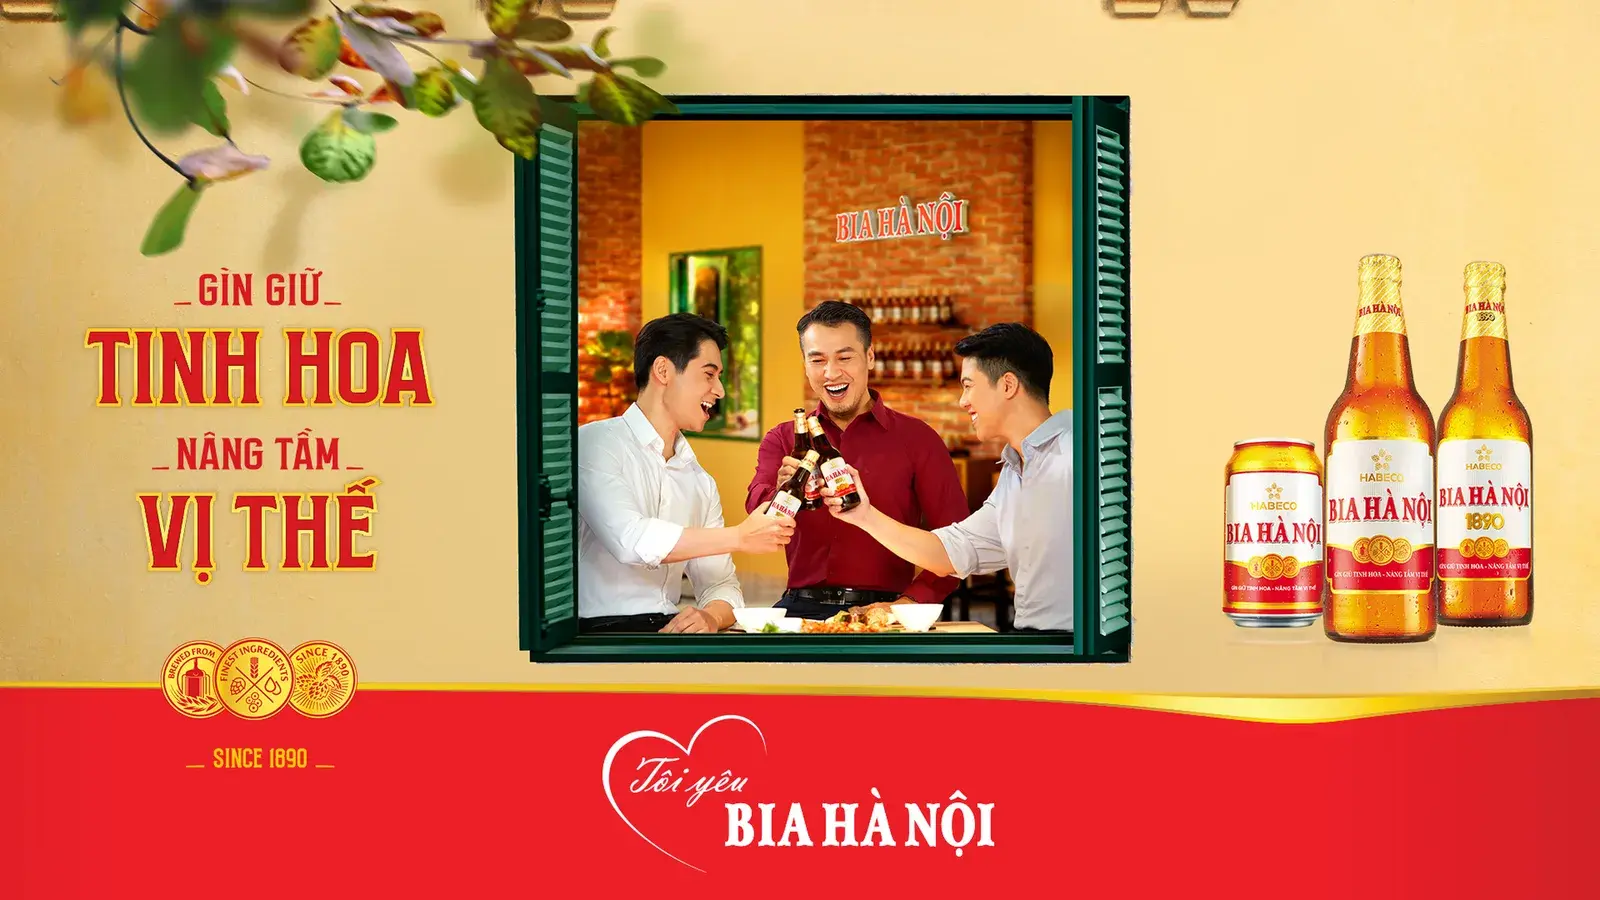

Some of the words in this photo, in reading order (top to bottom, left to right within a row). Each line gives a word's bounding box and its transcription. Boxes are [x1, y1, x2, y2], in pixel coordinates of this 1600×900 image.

[836, 211, 873, 242] BIA
[877, 195, 913, 237] HÀ
[917, 192, 966, 240] NỘI
[198, 267, 253, 306] GÌN
[266, 267, 323, 306] GIỮ
[84, 327, 263, 407] TINH
[283, 327, 436, 407] HOA
[177, 431, 263, 470] NÂNG
[274, 427, 340, 470] TẦM
[1360, 473, 1404, 482] HABECO
[1439, 486, 1466, 507] BIA
[1469, 480, 1498, 507] HÀ
[1501, 483, 1529, 511] NỘI
[1251, 501, 1297, 510] HABECO
[1329, 497, 1360, 522] BIA
[1363, 488, 1399, 521] HÀ
[1402, 492, 1432, 528] NỘI
[1465, 512, 1505, 530] 1890
[136, 491, 216, 585] VỊ
[231, 475, 382, 571] THẾ
[1227, 522, 1253, 544] BIA
[1257, 515, 1290, 544] HÀ
[1292, 518, 1321, 549] NỘI
[167, 651, 191, 679] BREWED
[191, 647, 216, 658] FROM
[220, 652, 239, 682] FINEST
[240, 645, 289, 682] INGREDIENTS
[295, 647, 328, 664] SINCE
[330, 652, 350, 676] 1890
[212, 748, 263, 769] SINCE
[269, 748, 307, 769] 1890
[629, 757, 690, 793] Tôi
[684, 769, 749, 808] yêu
[724, 802, 813, 848] BIA
[822, 786, 896, 848] HÀ
[904, 789, 995, 857] NỘI
